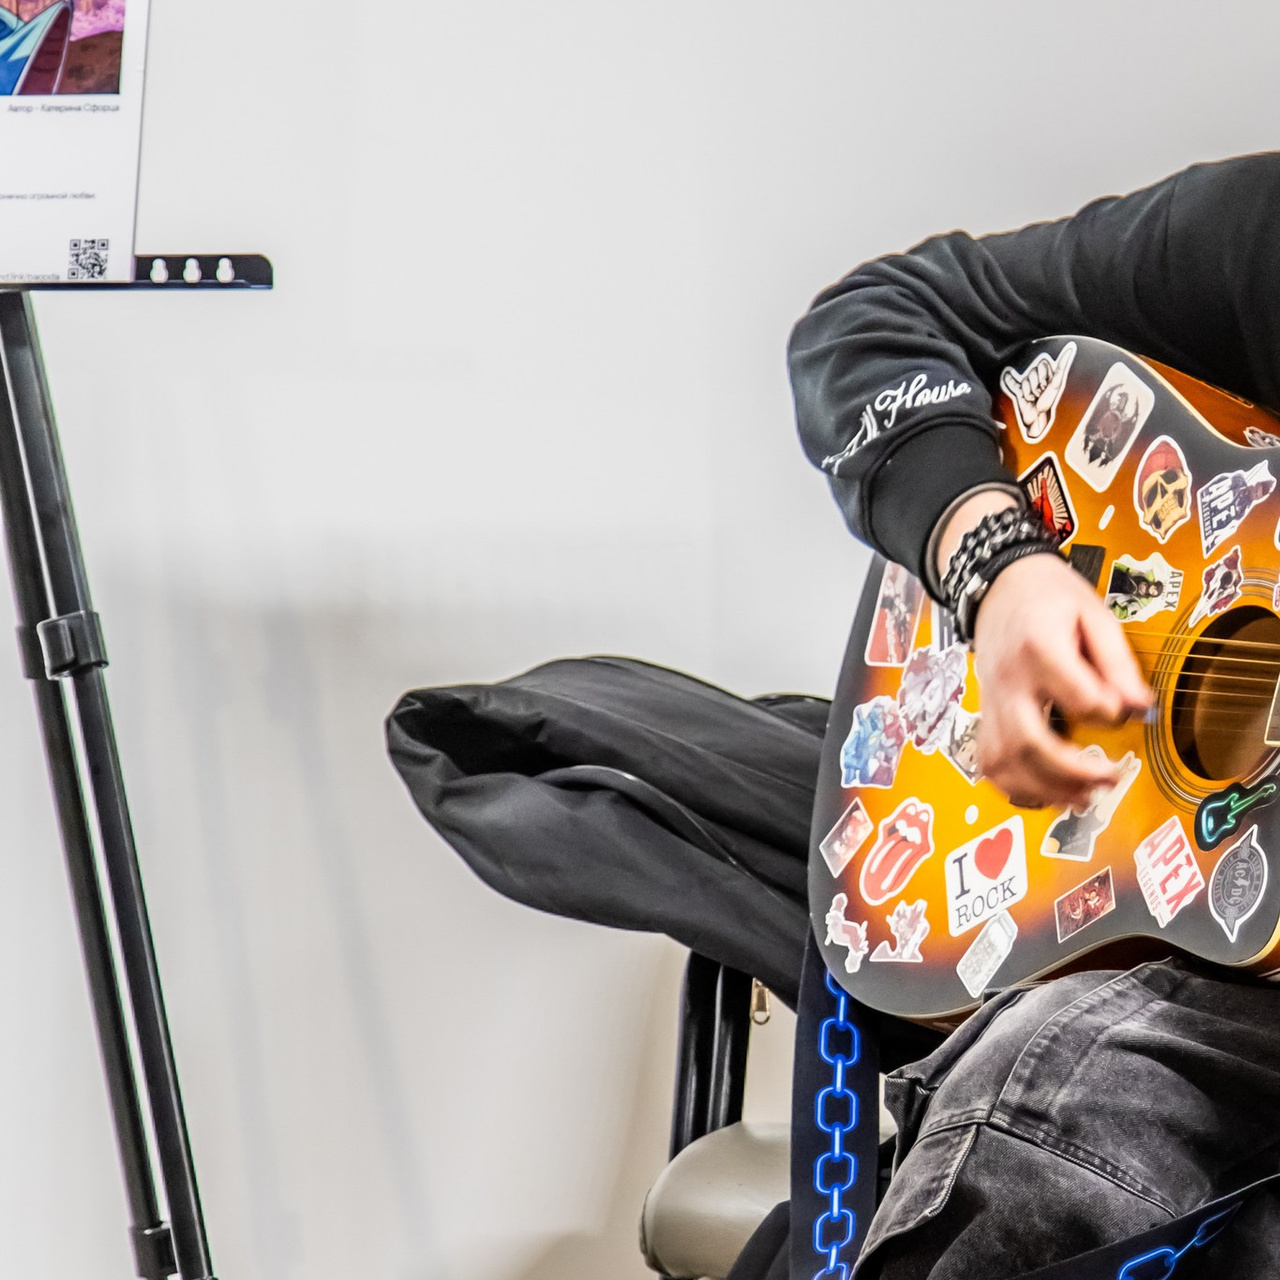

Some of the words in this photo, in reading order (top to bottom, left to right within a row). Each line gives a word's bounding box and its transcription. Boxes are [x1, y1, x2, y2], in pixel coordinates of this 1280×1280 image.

[1164, 571, 1183, 609] APEX
[952, 852, 971, 900] I
[1138, 866, 1162, 912] LEGENDS
[1143, 817, 1202, 916] APEX
[956, 875, 1017, 928] ROCK
